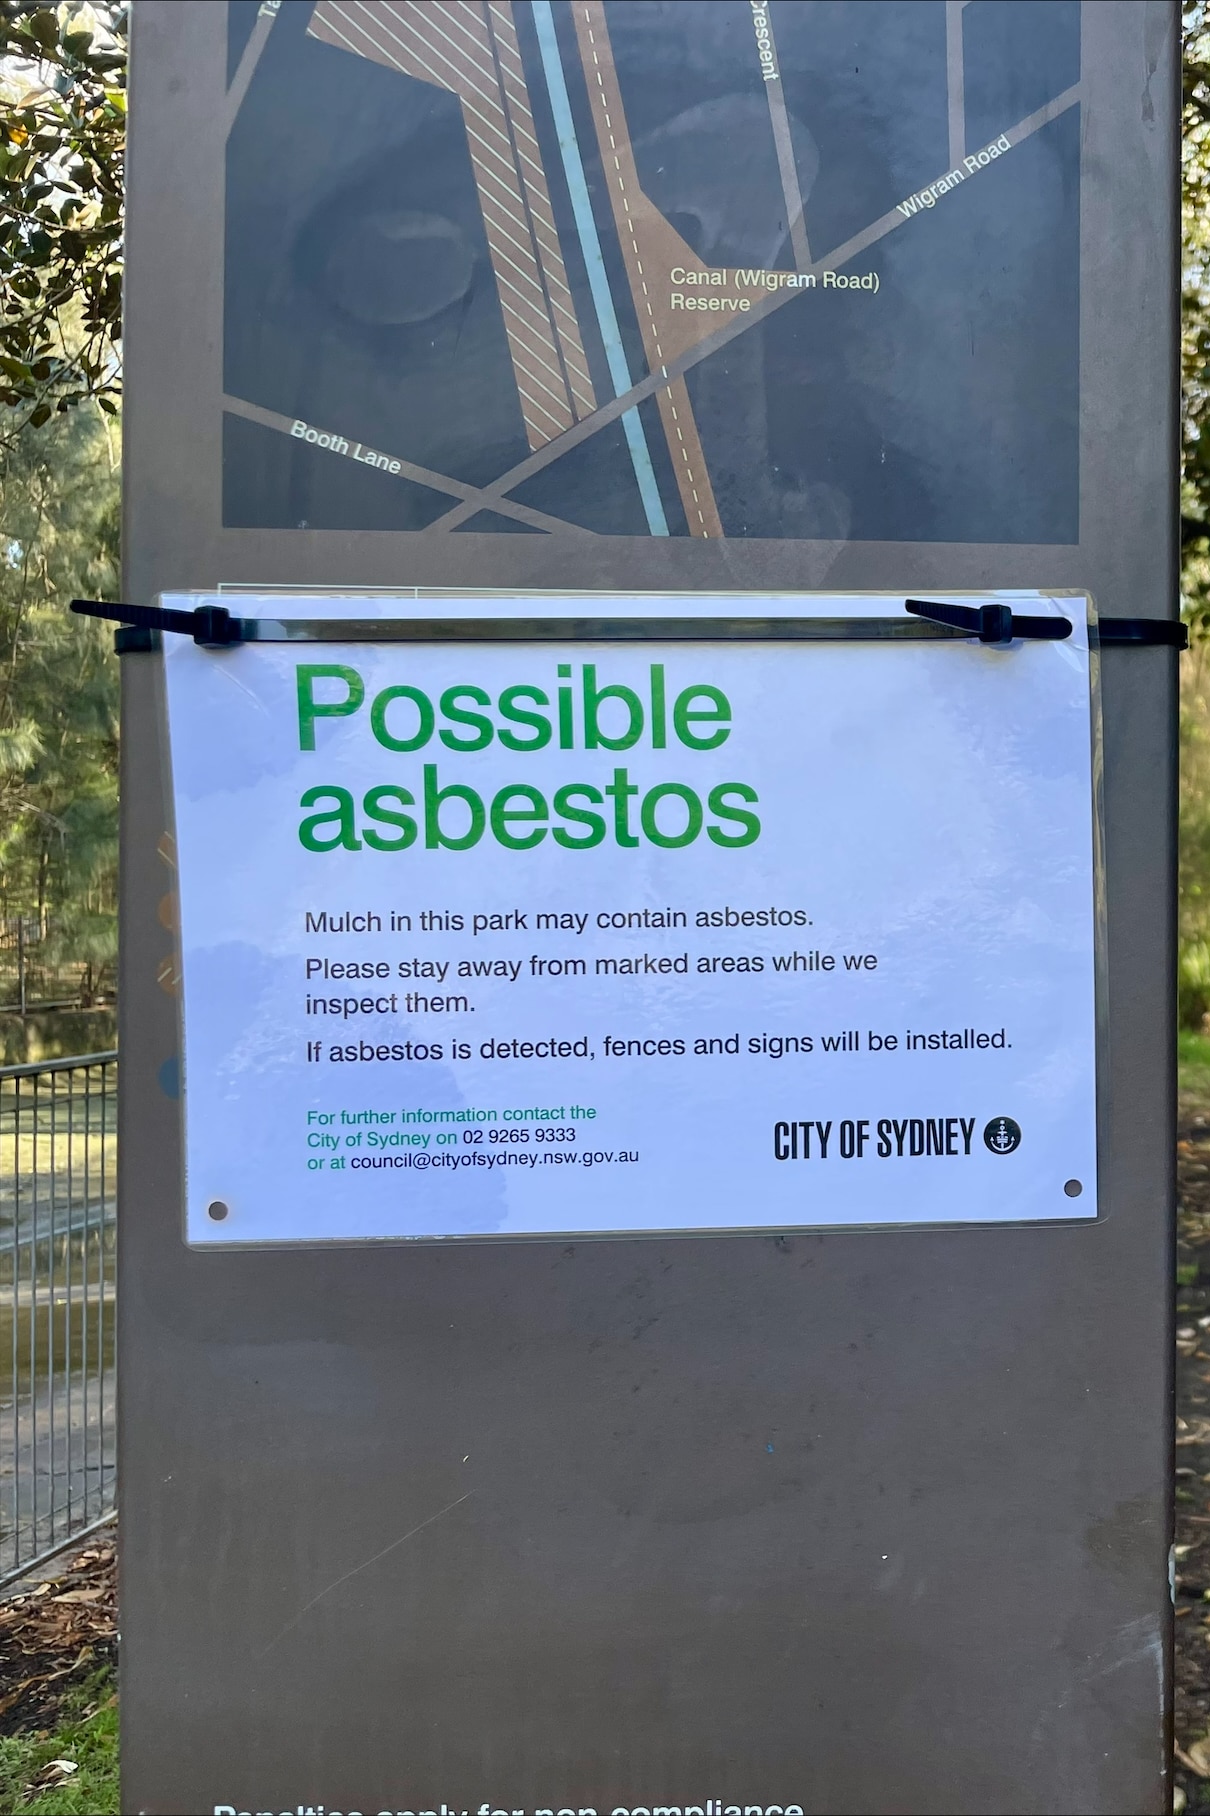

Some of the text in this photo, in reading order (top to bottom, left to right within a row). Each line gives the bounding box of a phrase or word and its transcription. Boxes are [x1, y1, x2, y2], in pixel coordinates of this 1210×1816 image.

[896, 134, 1011, 218] Wigram Road
[670, 268, 880, 293] Canal (Wigram Road)
[670, 293, 750, 311] Reserve
[290, 420, 401, 474] Booth Lane
[295, 664, 732, 752] Possible
[298, 764, 761, 852] asbestos
[306, 906, 813, 935] Mulch in this park may contain asbestos.
[306, 951, 878, 982] Please stay away from marked areas while we
[306, 992, 475, 1019] inspect them.
[307, 1029, 1012, 1062] If asbestos is detected, fences and signs will be installed.
[307, 1105, 597, 1125] For further information contact the
[307, 1128, 576, 1151] City of Sydney on 02 9265 9333
[774, 1118, 976, 1160] CITY OF SYDNEY
[307, 1150, 639, 1170] or at council@cityofsydney.nsw.gov.au
